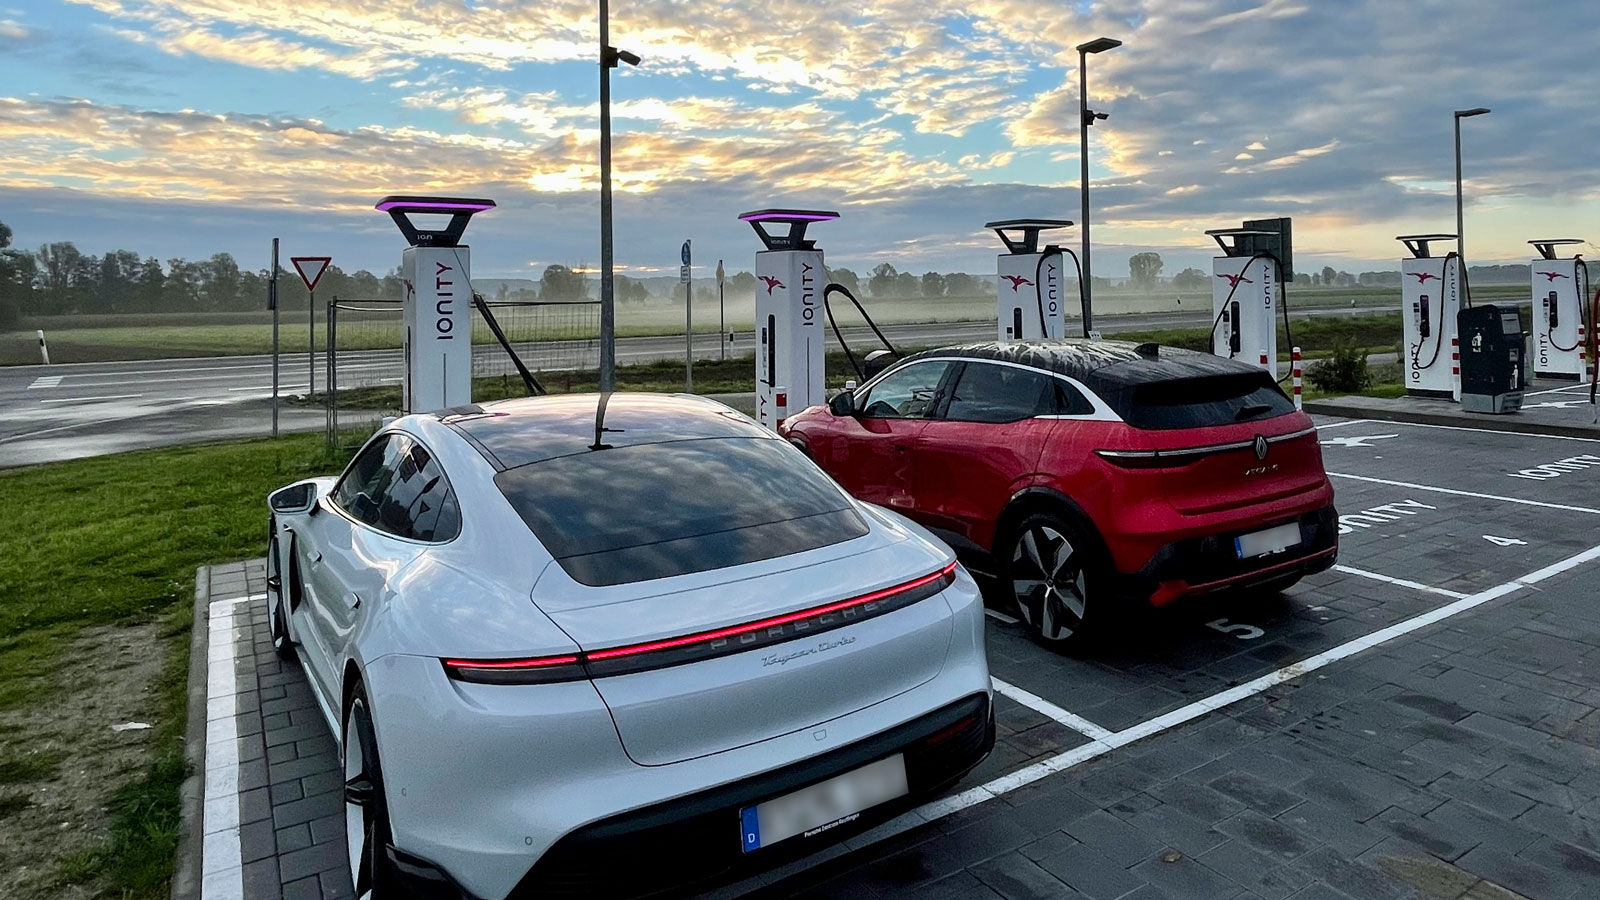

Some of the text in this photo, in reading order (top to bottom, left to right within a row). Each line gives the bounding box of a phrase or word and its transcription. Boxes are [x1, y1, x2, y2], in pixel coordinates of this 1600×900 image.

[436, 262, 453, 340] IONITY
[802, 262, 814, 326] IONITY
[1048, 263, 1057, 317] IONITY
[1263, 265, 1271, 309] IONITY
[1411, 342, 1420, 383] IONITY
[1540, 332, 1548, 367] IONITY
[1338, 499, 1437, 534] NITY
[1482, 535, 1528, 547] 4
[710, 602, 879, 651] PORSCHE
[1205, 618, 1265, 640] 5
[761, 637, 856, 667] Taycan Turbo
[748, 833, 756, 843] D
